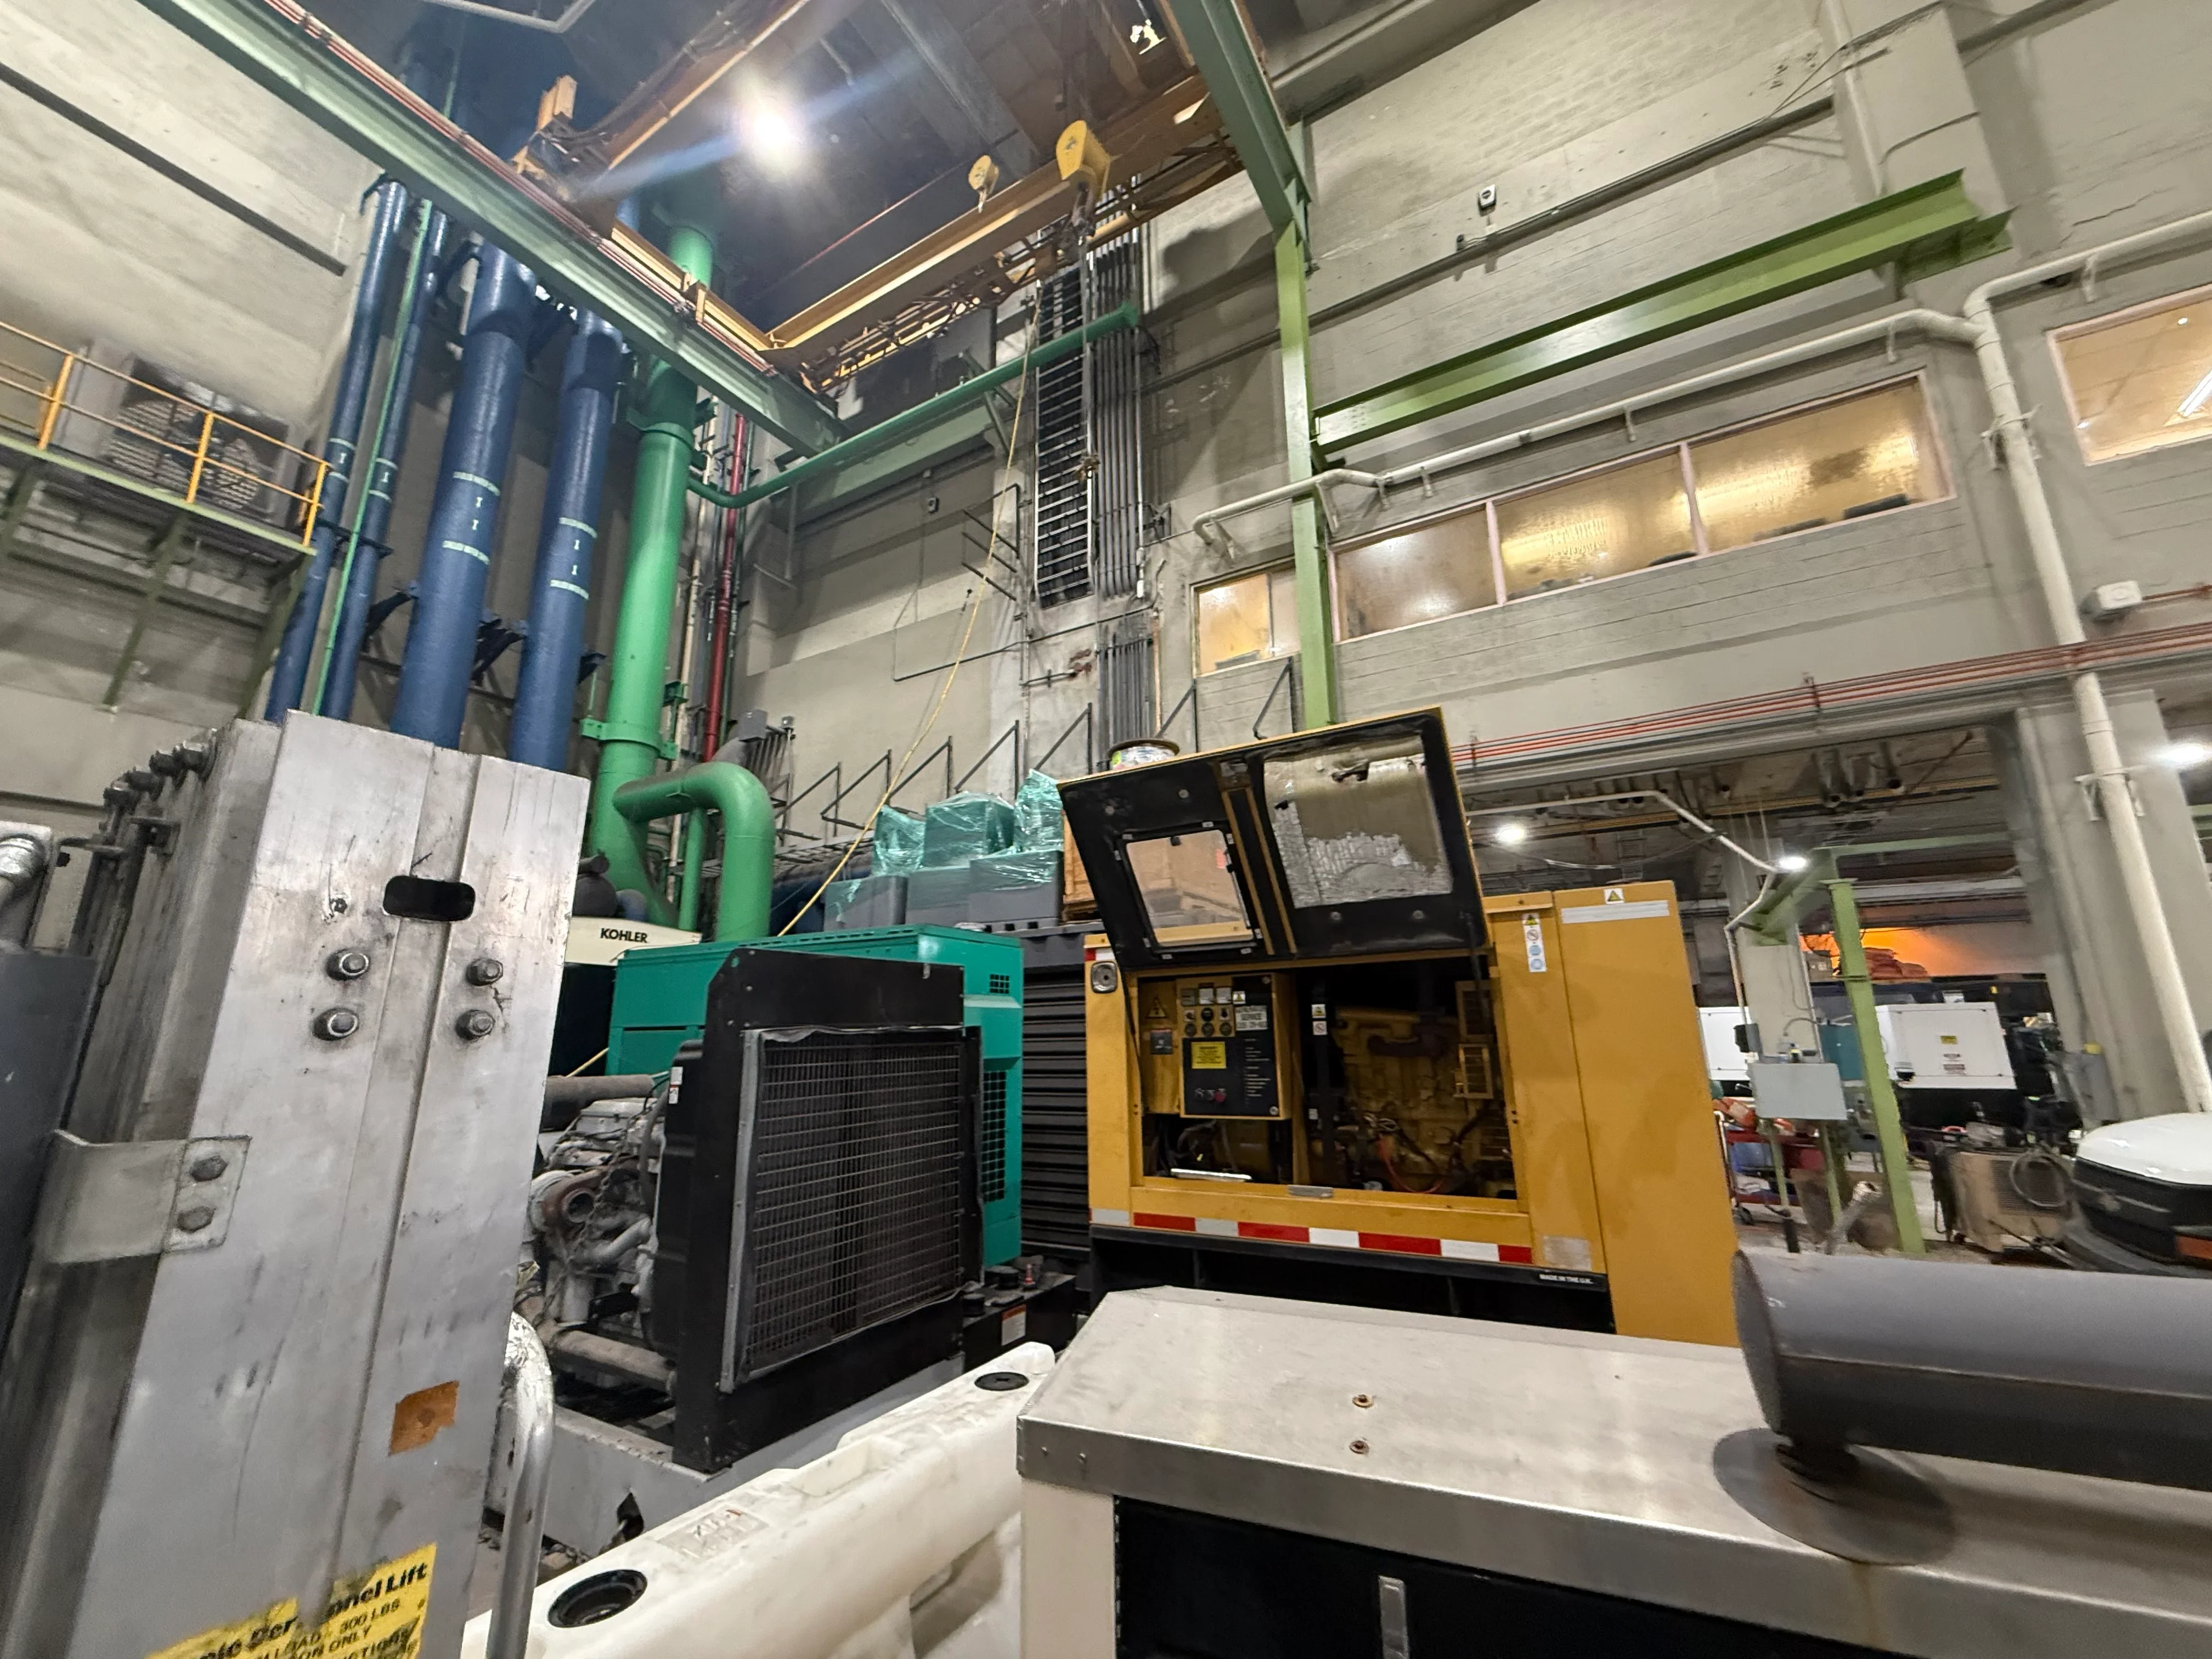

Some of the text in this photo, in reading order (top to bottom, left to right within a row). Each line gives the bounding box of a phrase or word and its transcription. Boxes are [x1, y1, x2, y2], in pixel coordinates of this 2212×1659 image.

[600, 928, 648, 943] KOHLER
[386, 1562, 427, 1595] Lift
[340, 1611, 368, 1635] 300
[329, 1624, 371, 1652] ONLY
